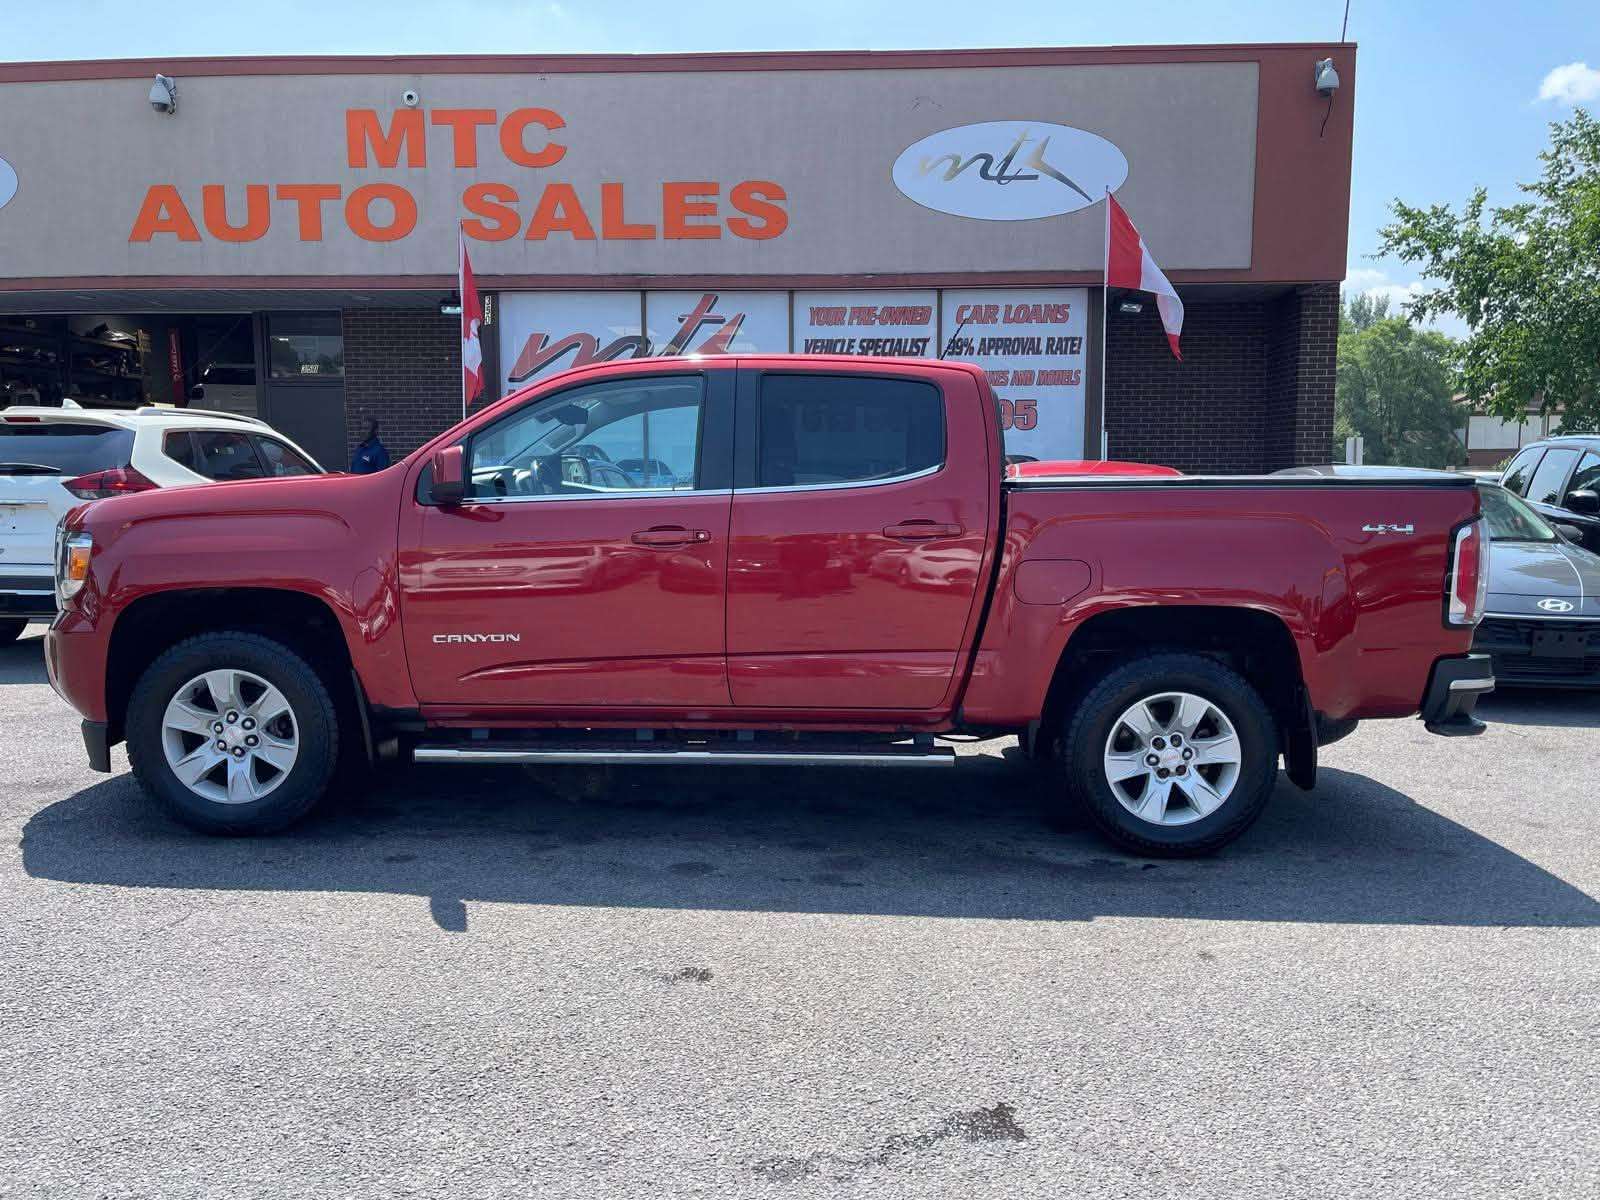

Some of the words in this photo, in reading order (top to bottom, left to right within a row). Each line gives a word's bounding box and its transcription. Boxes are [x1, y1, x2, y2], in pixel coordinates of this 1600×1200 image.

[346, 108, 567, 168] MTC
[128, 184, 418, 242] AUTO
[462, 180, 789, 240] SALES
[809, 306, 847, 326] YOUR
[848, 305, 932, 326] PRE-OWNED
[955, 304, 1000, 325] CAR
[1002, 303, 1071, 324] LOANS
[804, 338, 857, 354] VEHICLE
[857, 337, 930, 356] SPECIALIST
[977, 336, 1042, 355] APPROVAL
[1045, 336, 1082, 355] RATE!
[1010, 370, 1035, 386] AND
[1036, 369, 1081, 386] MODELS
[432, 633, 521, 643] CANYON
